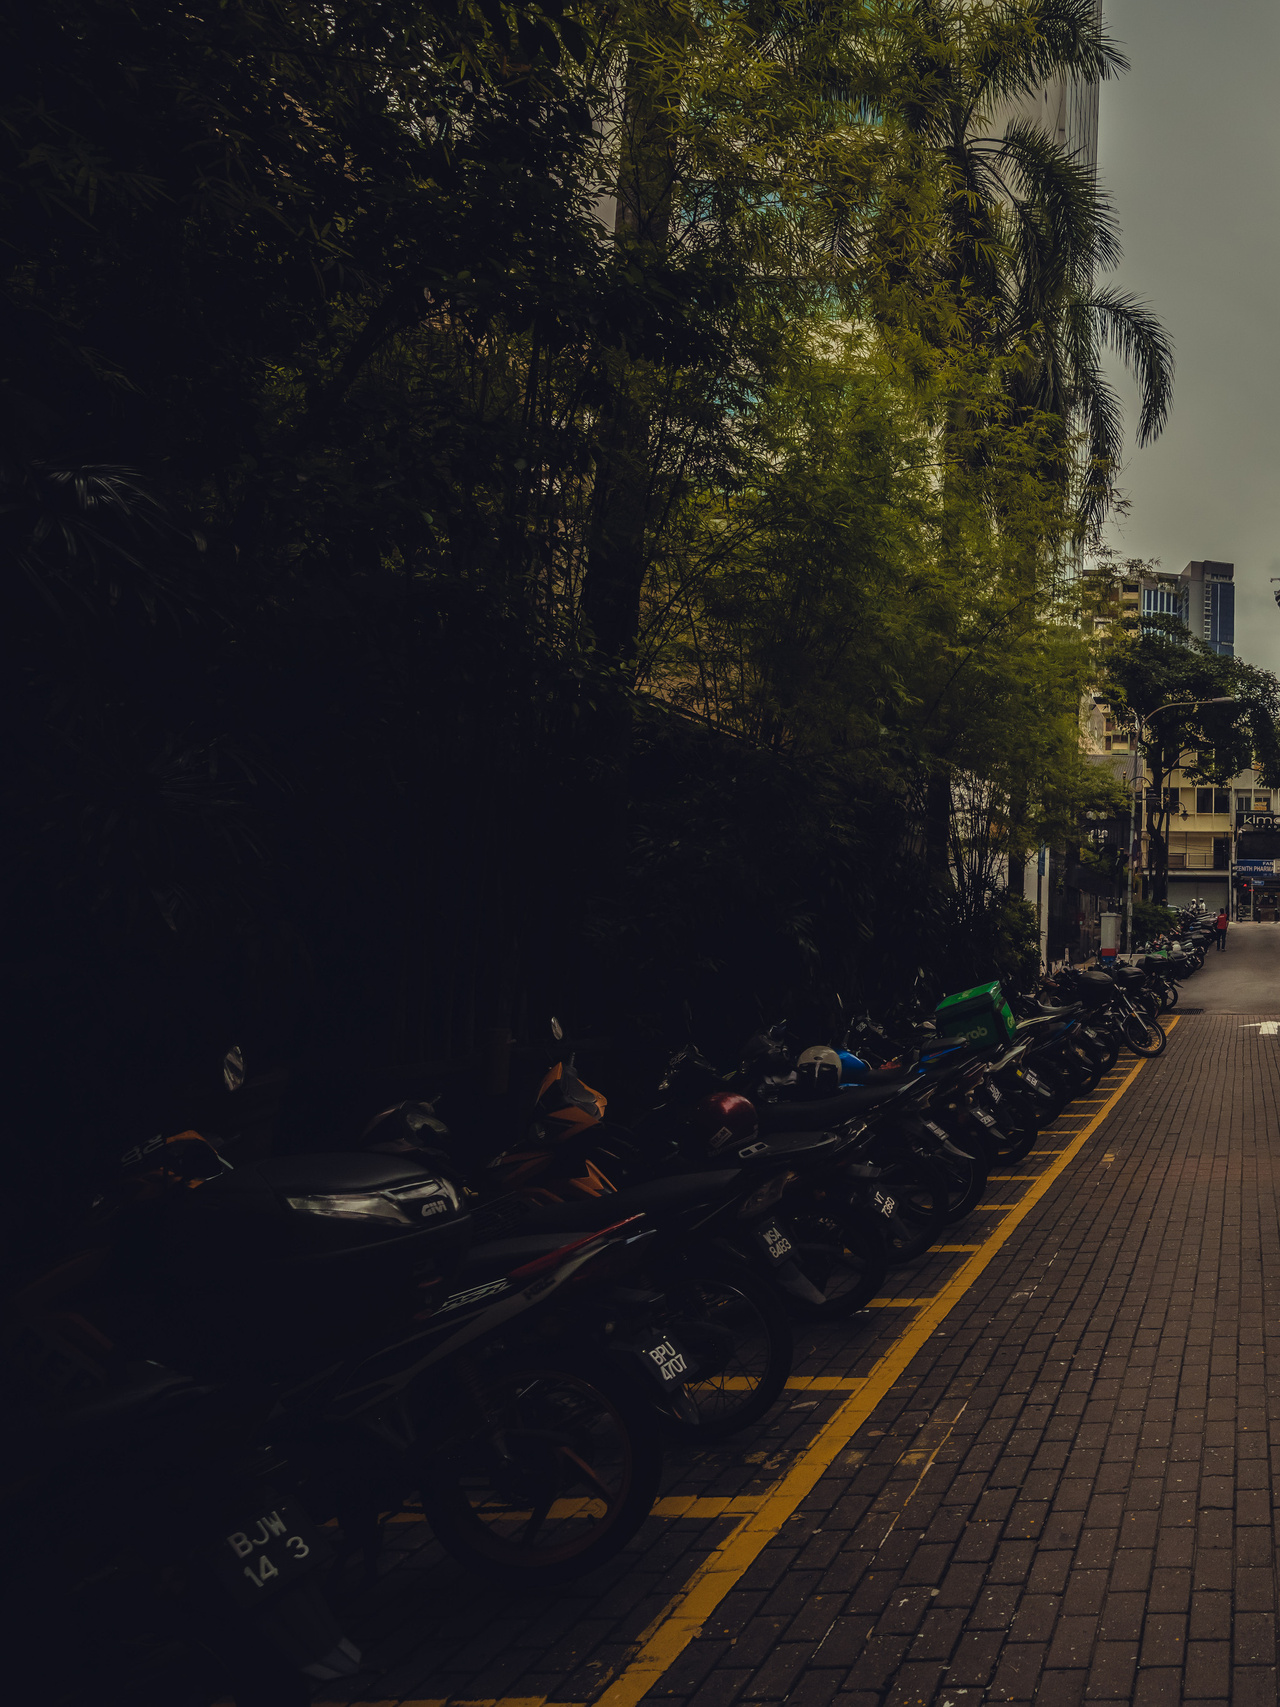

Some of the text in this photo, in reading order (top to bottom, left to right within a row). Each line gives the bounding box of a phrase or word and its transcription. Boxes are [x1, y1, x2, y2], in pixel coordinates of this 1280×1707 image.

[881, 1196, 896, 1218] 7360
[762, 1227, 782, 1245] WSA
[769, 1237, 792, 1259] 8483
[648, 1341, 676, 1366] BPU
[660, 1353, 688, 1381] 4707
[226, 1510, 288, 1559] BJW
